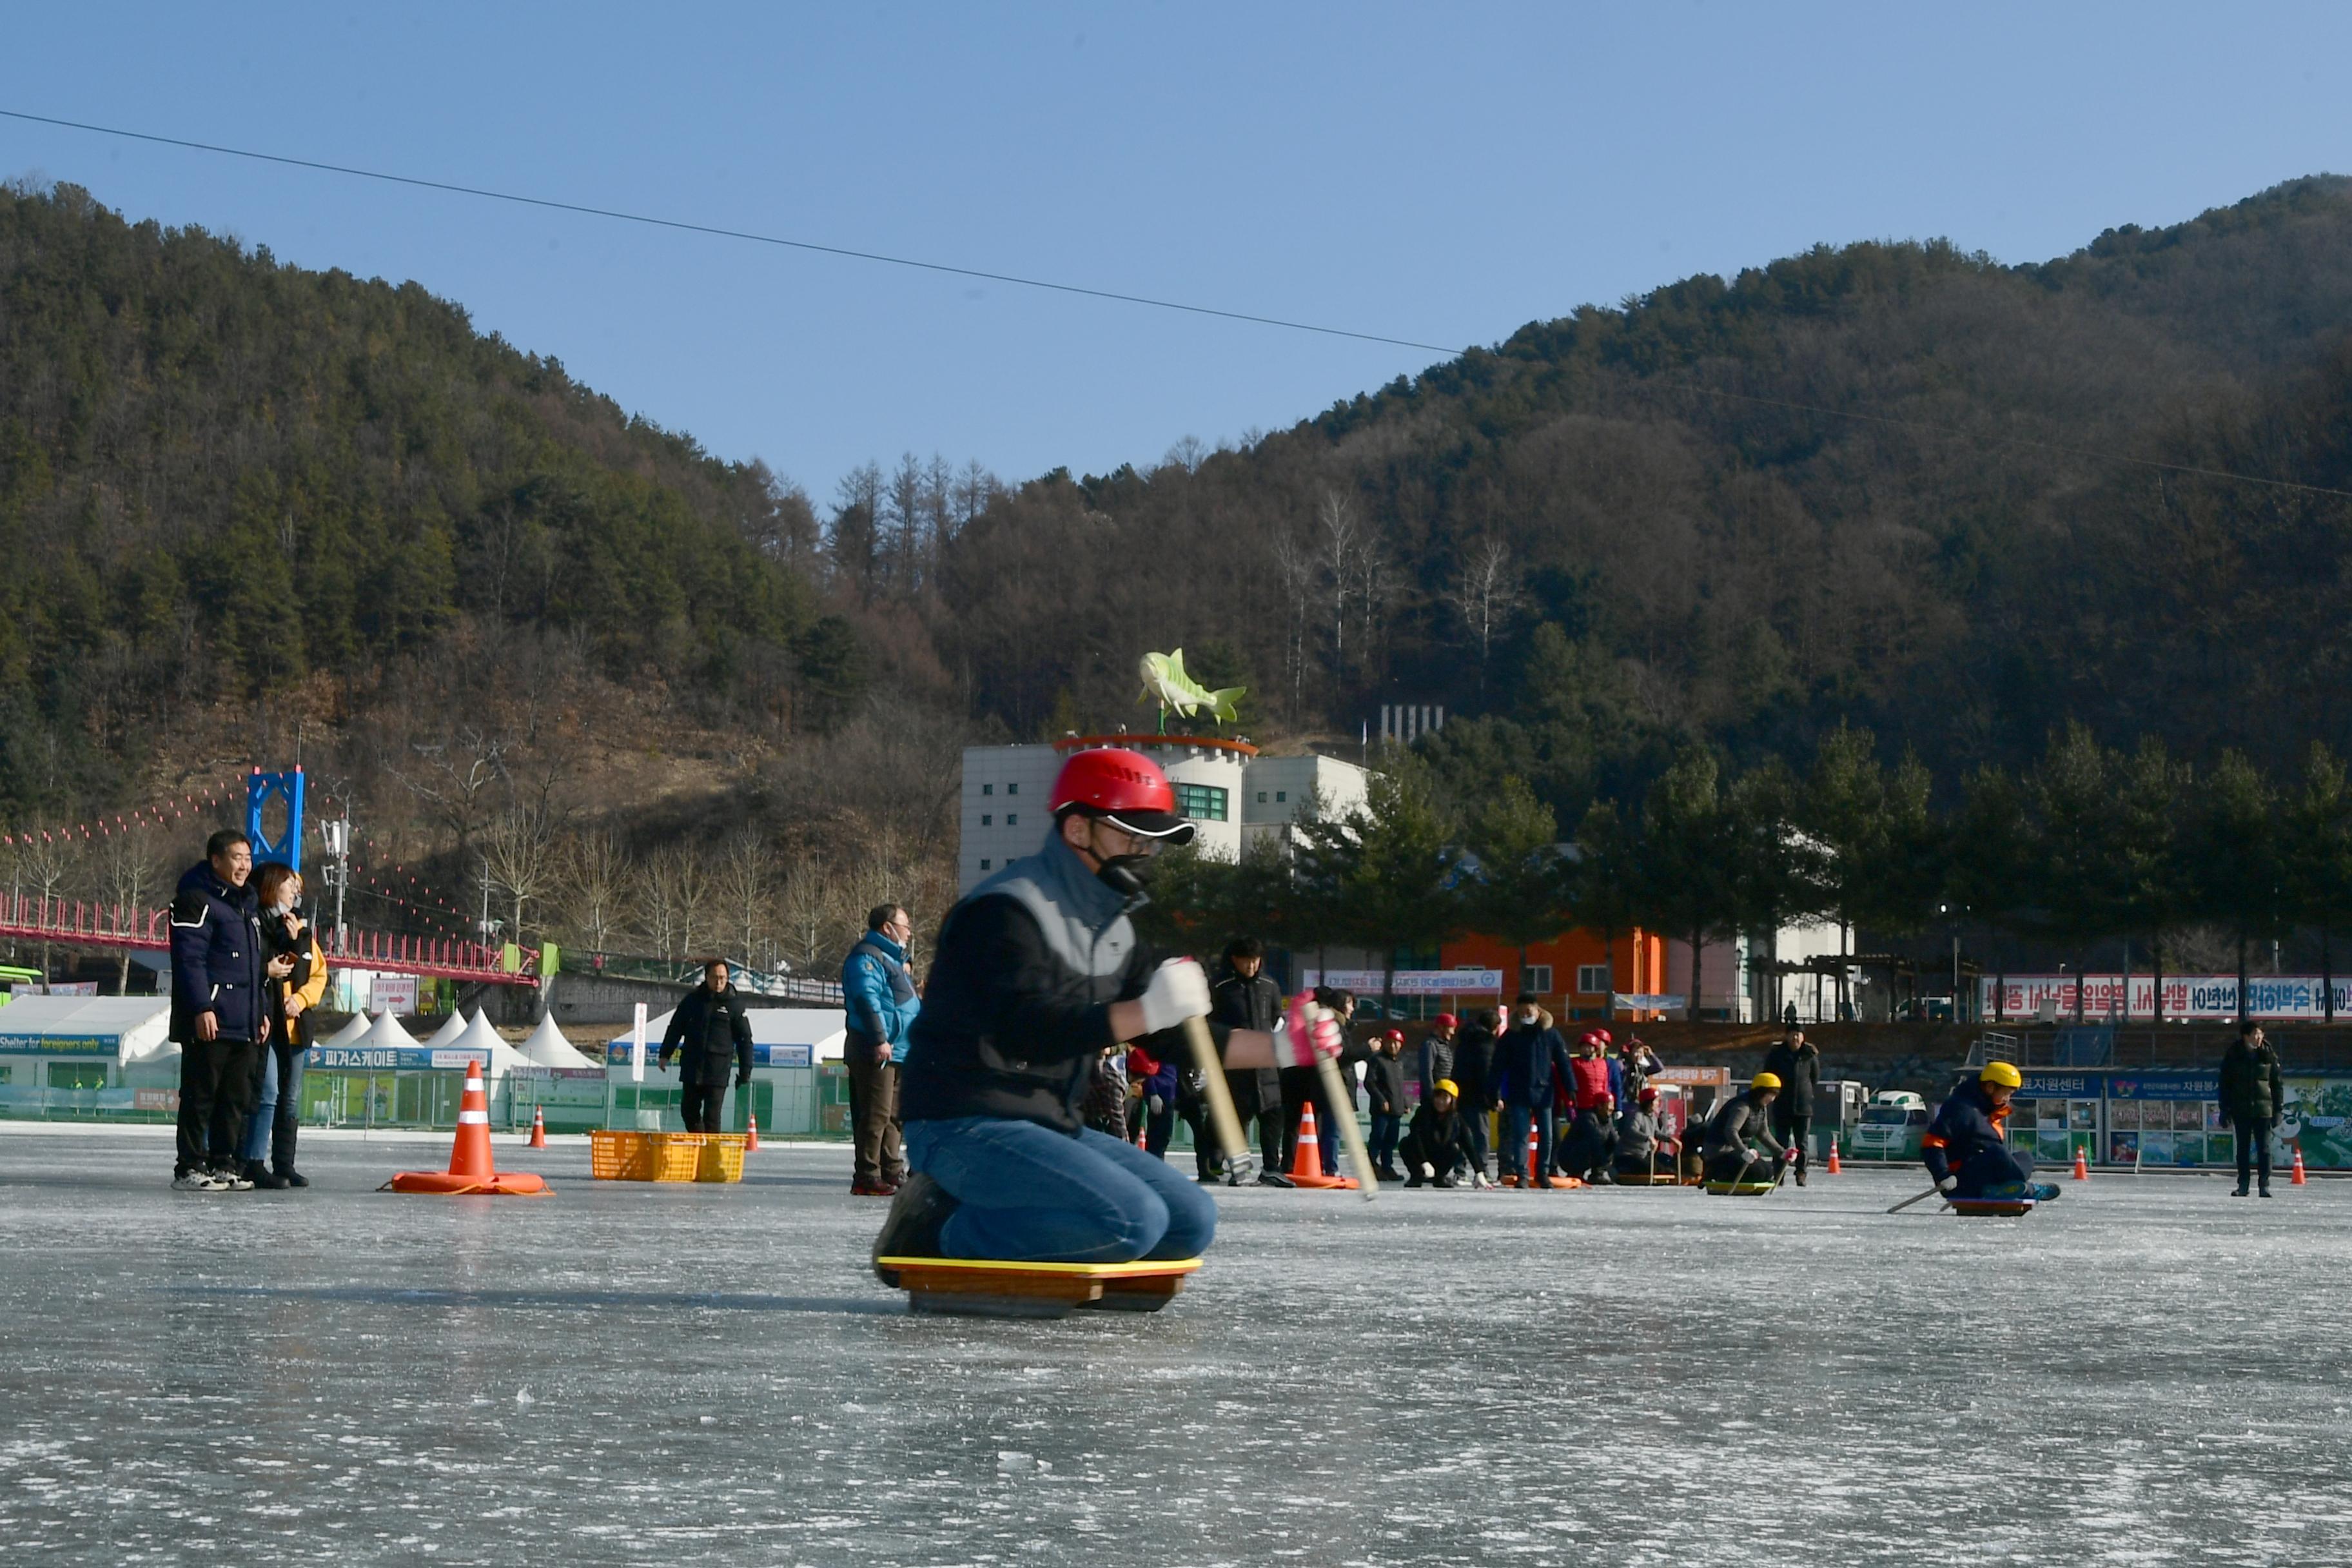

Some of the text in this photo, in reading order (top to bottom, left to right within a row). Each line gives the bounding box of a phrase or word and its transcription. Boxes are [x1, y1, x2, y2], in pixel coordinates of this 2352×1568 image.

[0, 1036, 27, 1049] Shelter
[28, 1036, 41, 1049] for
[41, 1037, 81, 1052] foreigners
[82, 1038, 99, 1052] only
[324, 1050, 398, 1066] 피겨스케이트
[1701, 1069, 1718, 1080] 입구
[2021, 1077, 2084, 1092] 료지원센터
